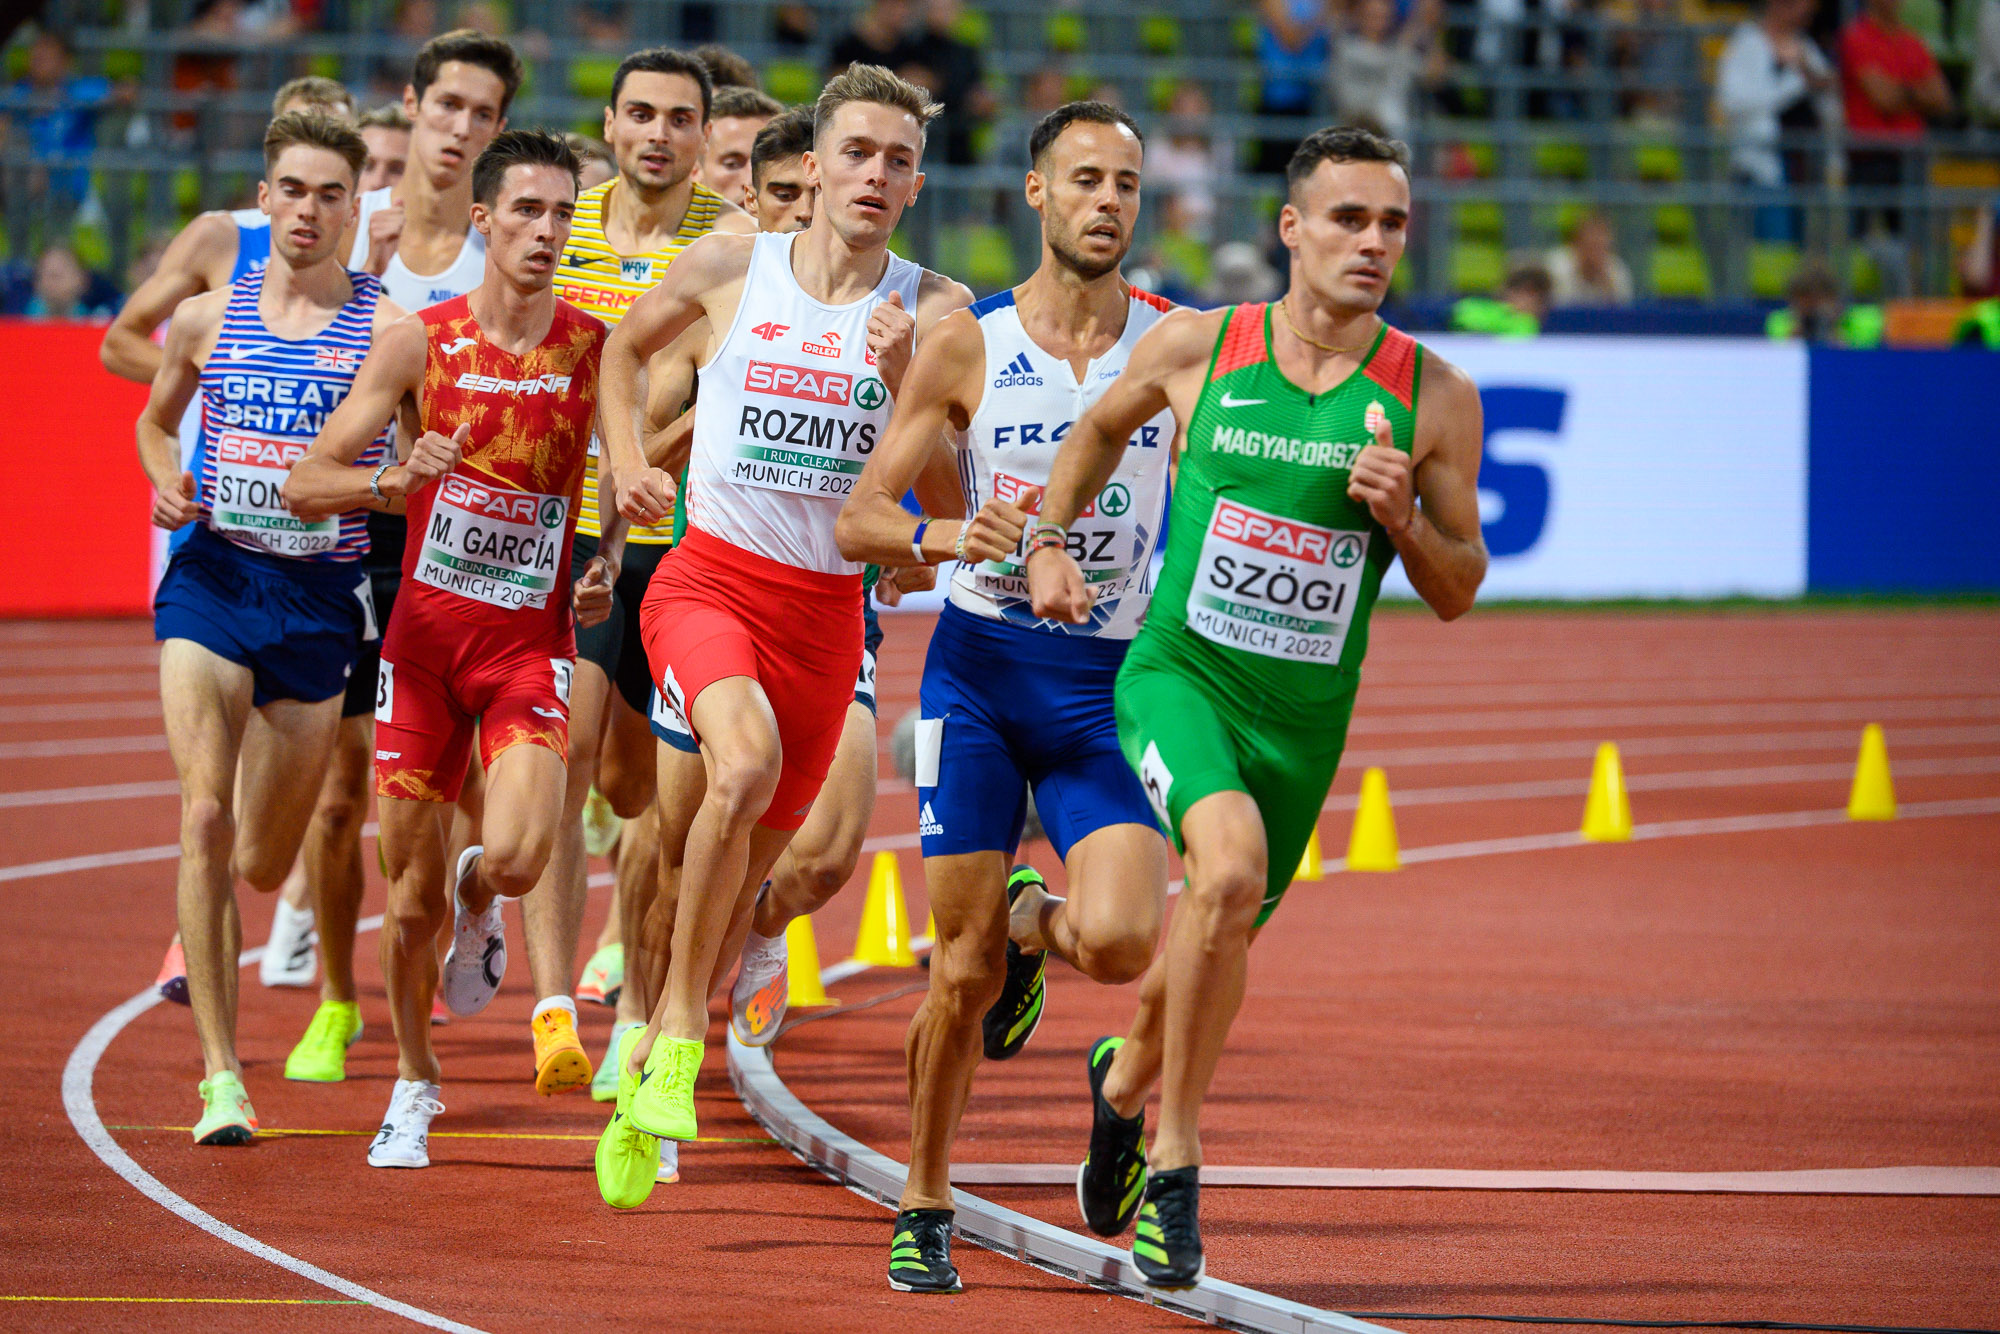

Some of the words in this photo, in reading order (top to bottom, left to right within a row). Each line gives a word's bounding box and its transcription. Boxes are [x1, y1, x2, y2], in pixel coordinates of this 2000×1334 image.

[562, 283, 638, 309] GERM
[751, 321, 791, 342] 4F
[803, 342, 840, 358] ORLEN
[222, 375, 350, 408] GREAT
[455, 372, 572, 396] ESPAÑA
[748, 366, 849, 401] SPAR
[994, 373, 1043, 389] adidas
[222, 403, 330, 433] BRITAI
[739, 405, 877, 455] ROZMYS
[220, 437, 307, 466] SPAR
[763, 448, 767, 460] I
[770, 449, 798, 465] RUN
[220, 475, 289, 510] STON
[735, 462, 813, 489] MUNICH
[818, 475, 857, 495] 202
[443, 479, 536, 522] SPAR
[243, 515, 268, 528] RUN
[269, 518, 306, 531] CLEAN
[1216, 508, 1327, 560] SPAR
[288, 535, 330, 551] 2022
[430, 513, 453, 548] M.
[463, 526, 555, 571] GARCÍA
[424, 563, 496, 598] MUNICH
[449, 557, 455, 567] I
[457, 560, 483, 574] RUN
[1209, 554, 1347, 615] SZÖGI
[1224, 602, 1231, 613] I
[1233, 604, 1264, 622] RUN
[1196, 611, 1279, 650] MUNICH
[1284, 635, 1333, 657] 2022
